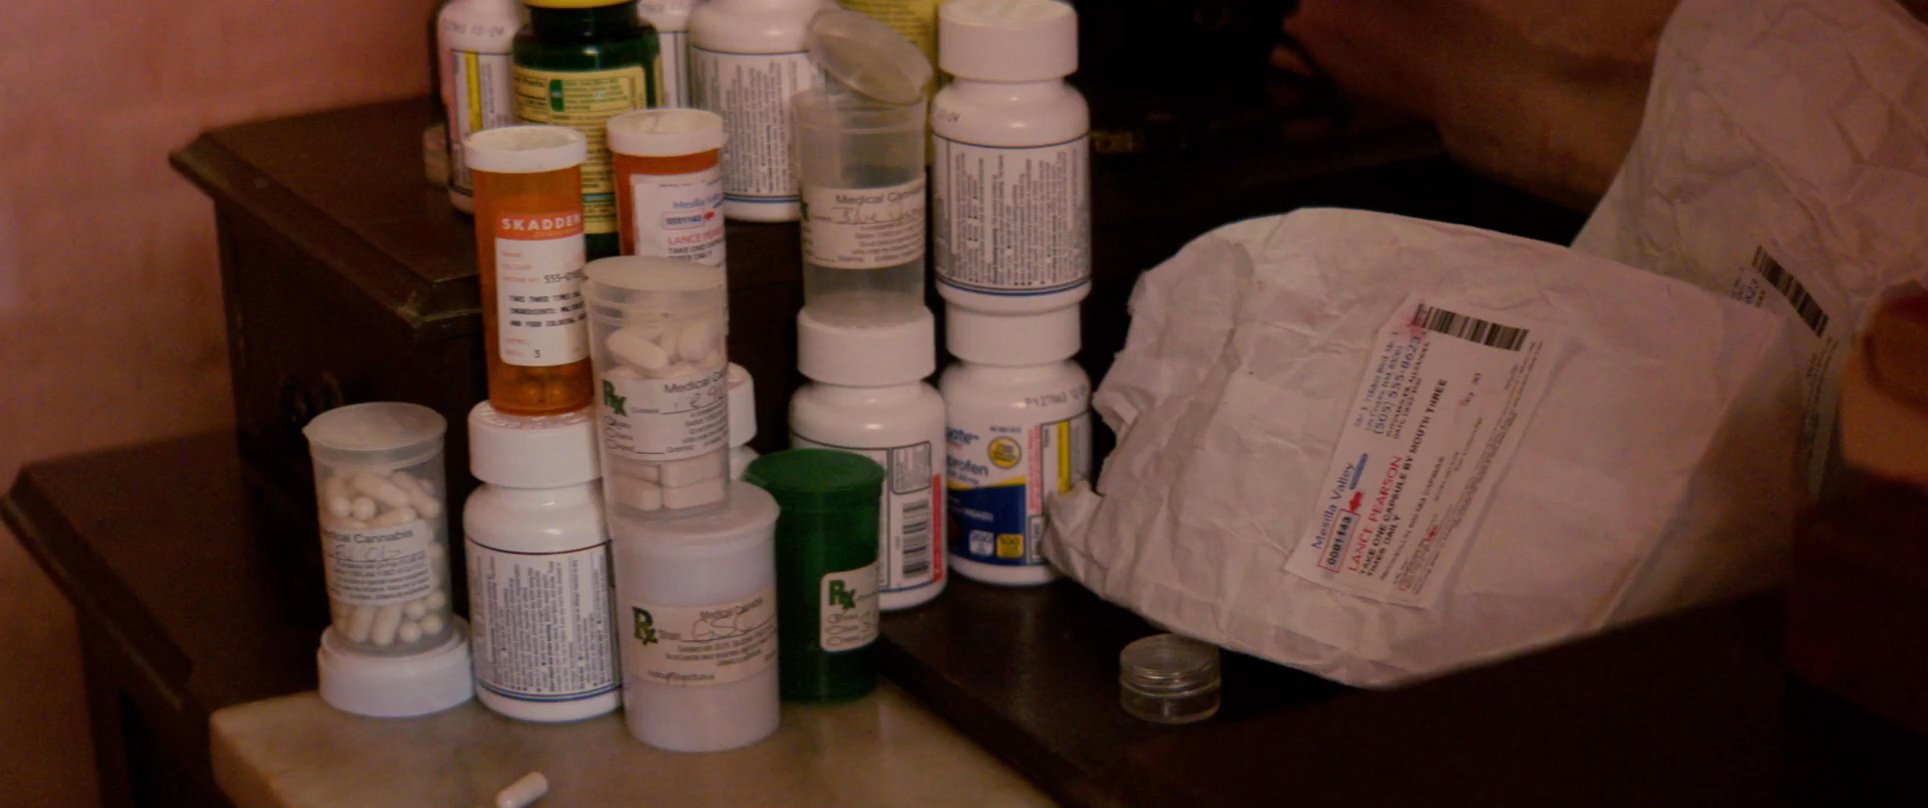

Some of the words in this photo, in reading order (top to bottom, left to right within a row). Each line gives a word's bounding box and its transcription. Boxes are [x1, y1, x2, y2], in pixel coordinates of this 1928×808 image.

[501, 213, 581, 231] SKADDEN
[1374, 400, 1395, 435] (505)
[1313, 503, 1337, 549] Mesilla
[1332, 461, 1356, 501] Valley
[1349, 527, 1372, 571] LANCE
[1369, 454, 1402, 522] PEARSON
[1362, 548, 1375, 574] TAKE
[1374, 524, 1386, 546] ONE
[1384, 472, 1407, 522] CAPSULE
[1402, 455, 1413, 470] BY
[1410, 415, 1430, 454] MOUTH
[1426, 377, 1447, 415] THREE
[1369, 546, 1385, 576] TIMES
[1384, 514, 1400, 544] DAILY
